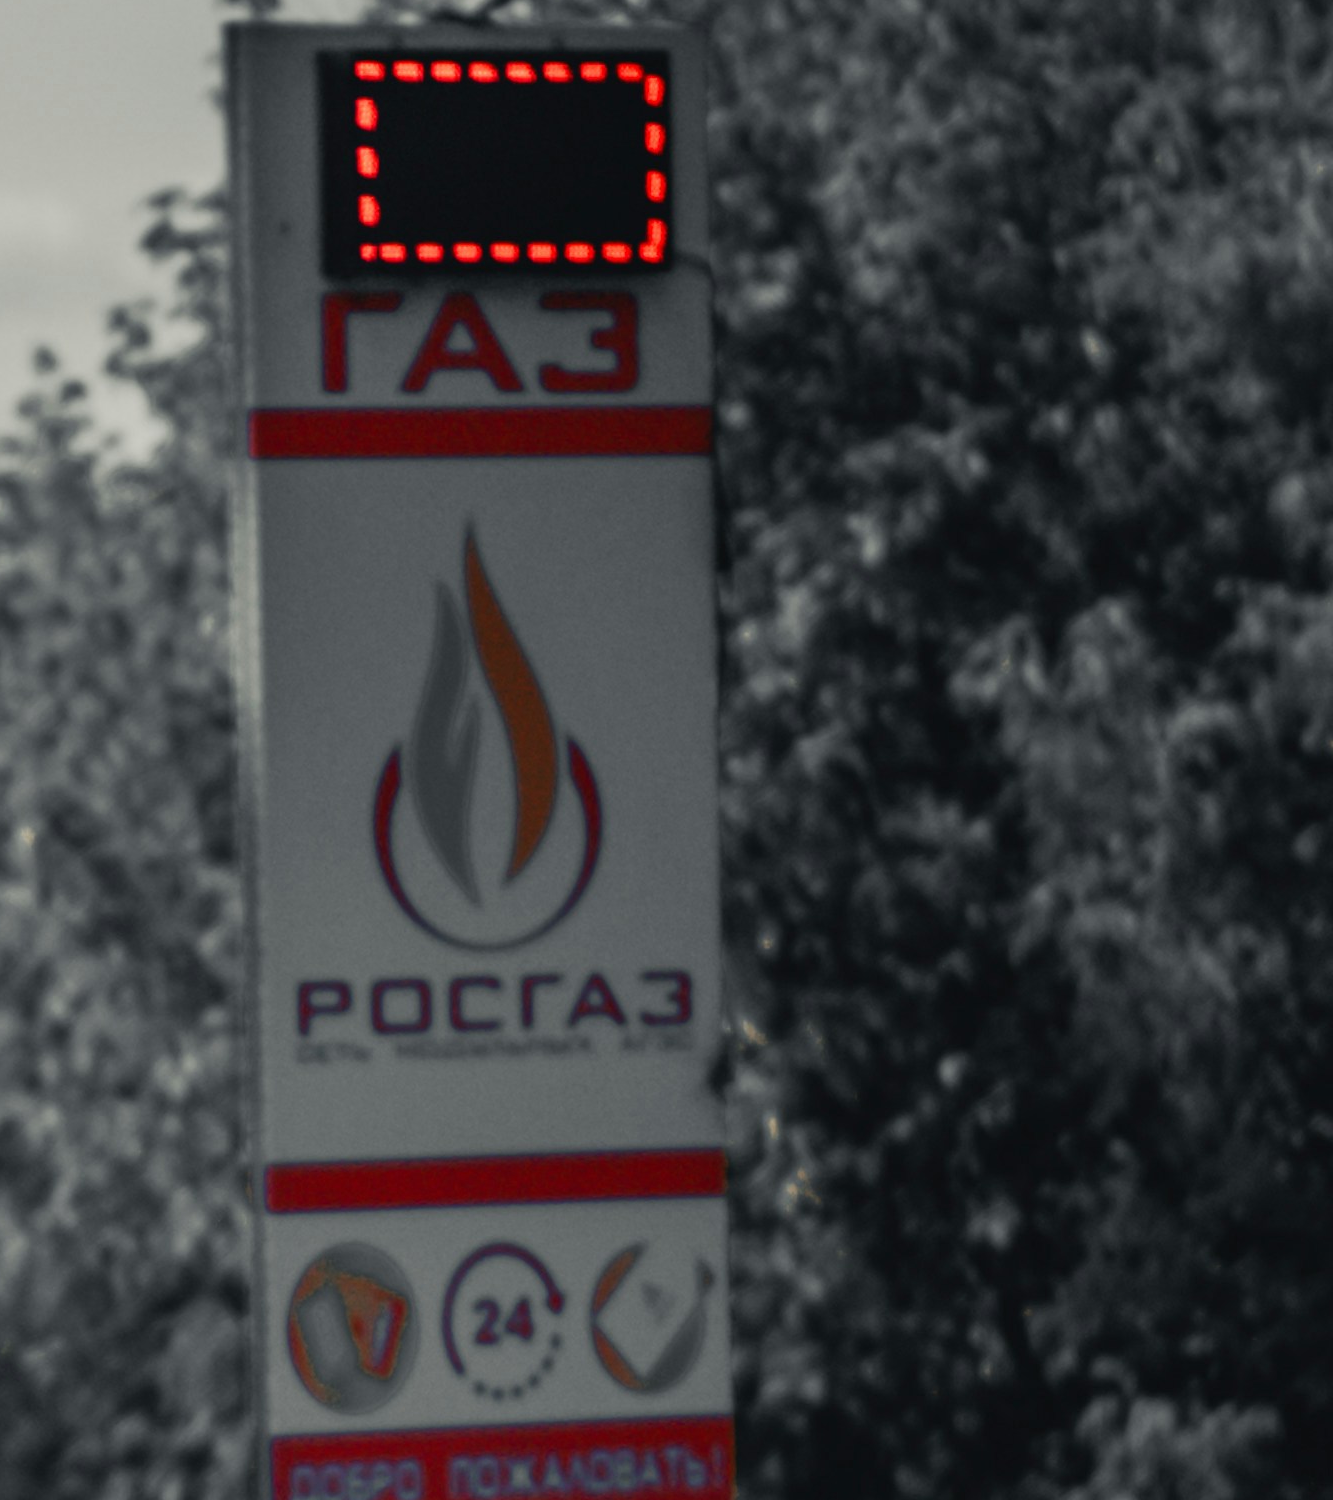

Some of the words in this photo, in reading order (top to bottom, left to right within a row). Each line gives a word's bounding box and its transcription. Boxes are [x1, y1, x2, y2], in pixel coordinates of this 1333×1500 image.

[322, 291, 638, 393] ГАЗ
[296, 971, 693, 1036] РОСГАЗ
[473, 1297, 534, 1346] 24
